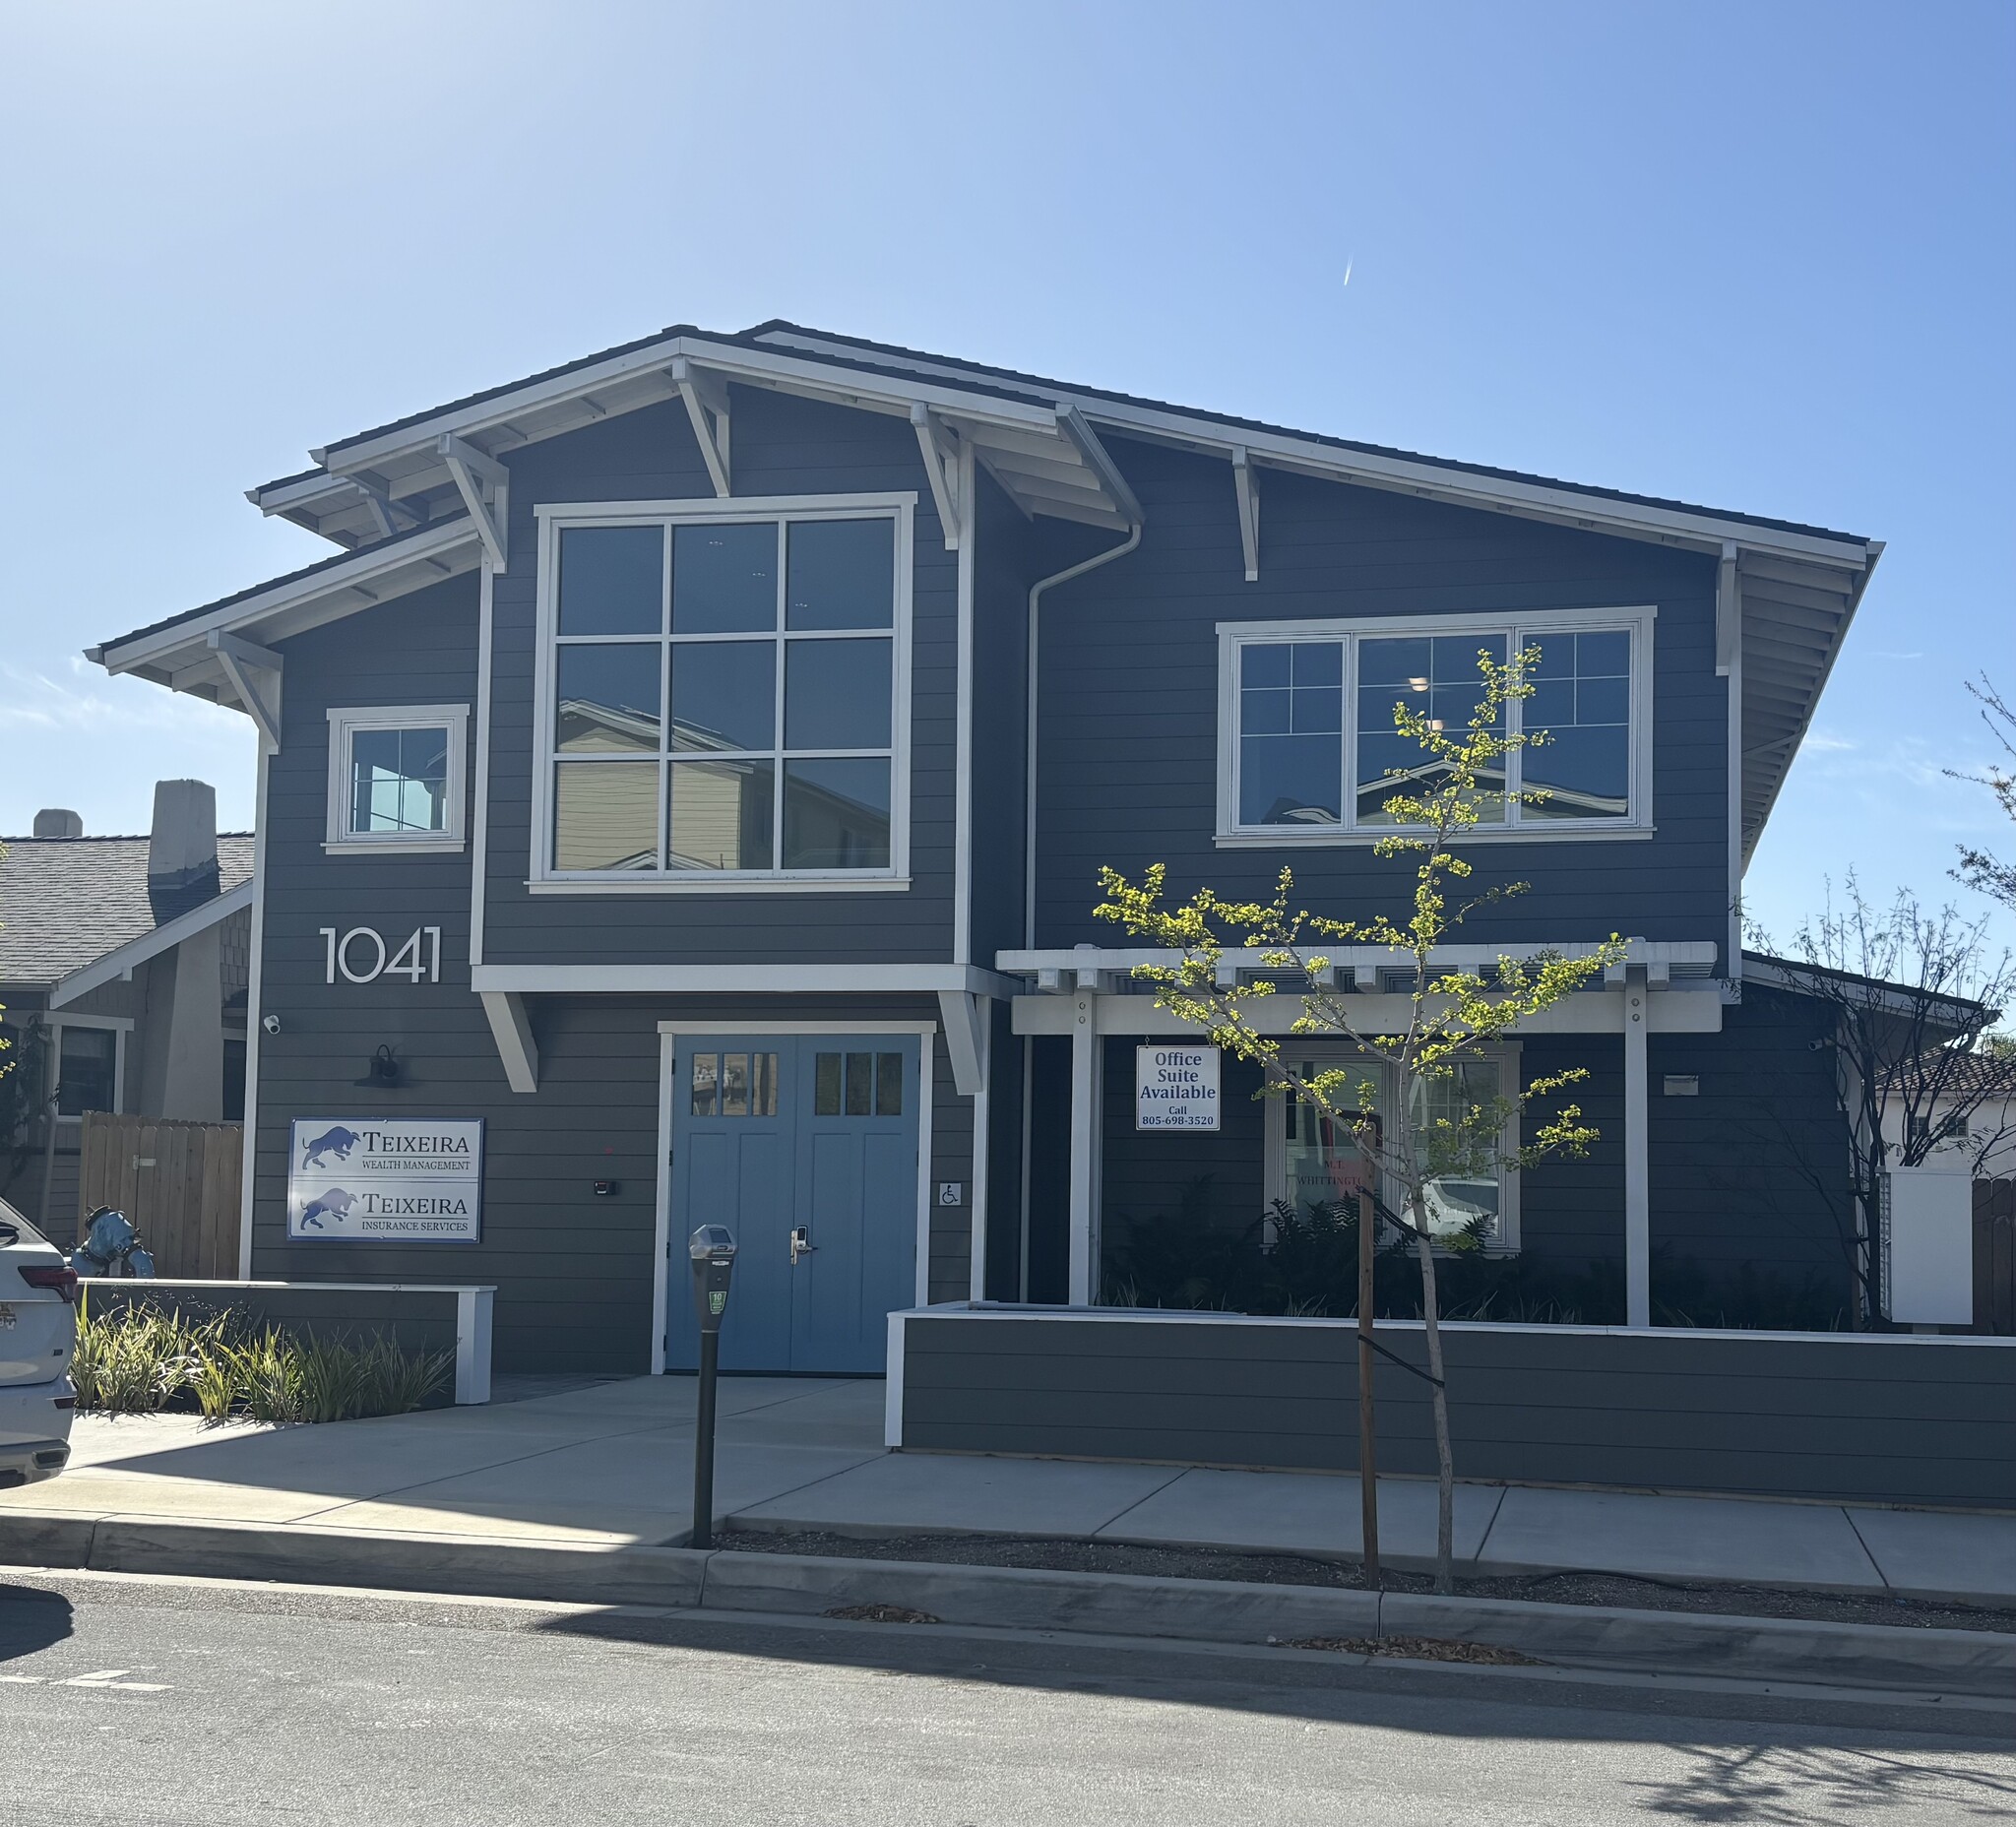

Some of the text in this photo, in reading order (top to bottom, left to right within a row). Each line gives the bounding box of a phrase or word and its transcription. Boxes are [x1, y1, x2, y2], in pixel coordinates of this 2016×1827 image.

[319, 925, 441, 984] 1041
[1155, 1051, 1202, 1066] Office
[1158, 1068, 1199, 1083] Suite
[1140, 1085, 1216, 1100] Available
[1142, 1116, 1214, 1125] 805-698-3520
[362, 1131, 470, 1153] TEIXEIRA
[362, 1160, 471, 1170] WEALTH MANAGEMENT
[361, 1193, 469, 1215] TEIXEIRA
[361, 1221, 469, 1231] INSURANCE SERVICES
